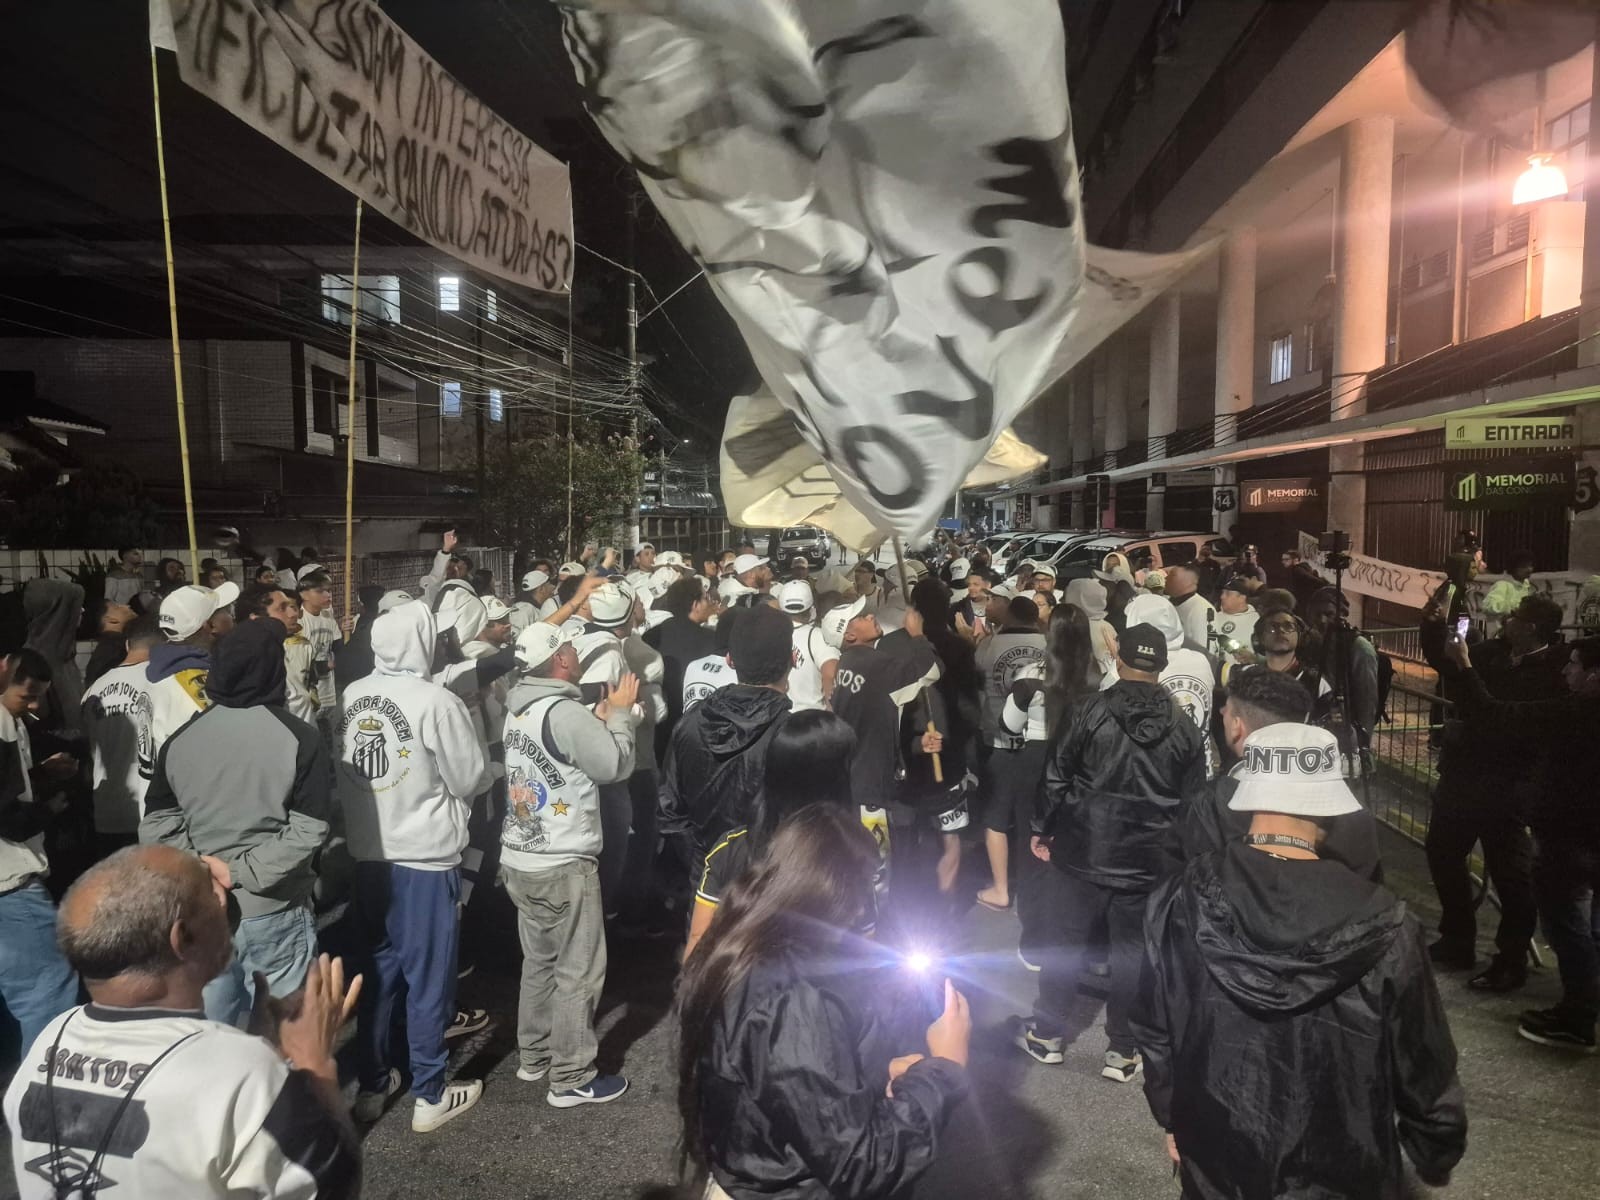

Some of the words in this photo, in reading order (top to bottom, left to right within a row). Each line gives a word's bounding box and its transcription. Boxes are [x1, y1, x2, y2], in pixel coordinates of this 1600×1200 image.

[1485, 424, 1575, 441] ENTRADA
[1485, 472, 1568, 487] MEMORIAL
[1267, 488, 1319, 498] MEMORIAL
[1216, 495, 1232, 508] 14
[702, 662, 723, 673] 013
[377, 697, 414, 743] JOVEM
[520, 733, 567, 790] JOVEM
